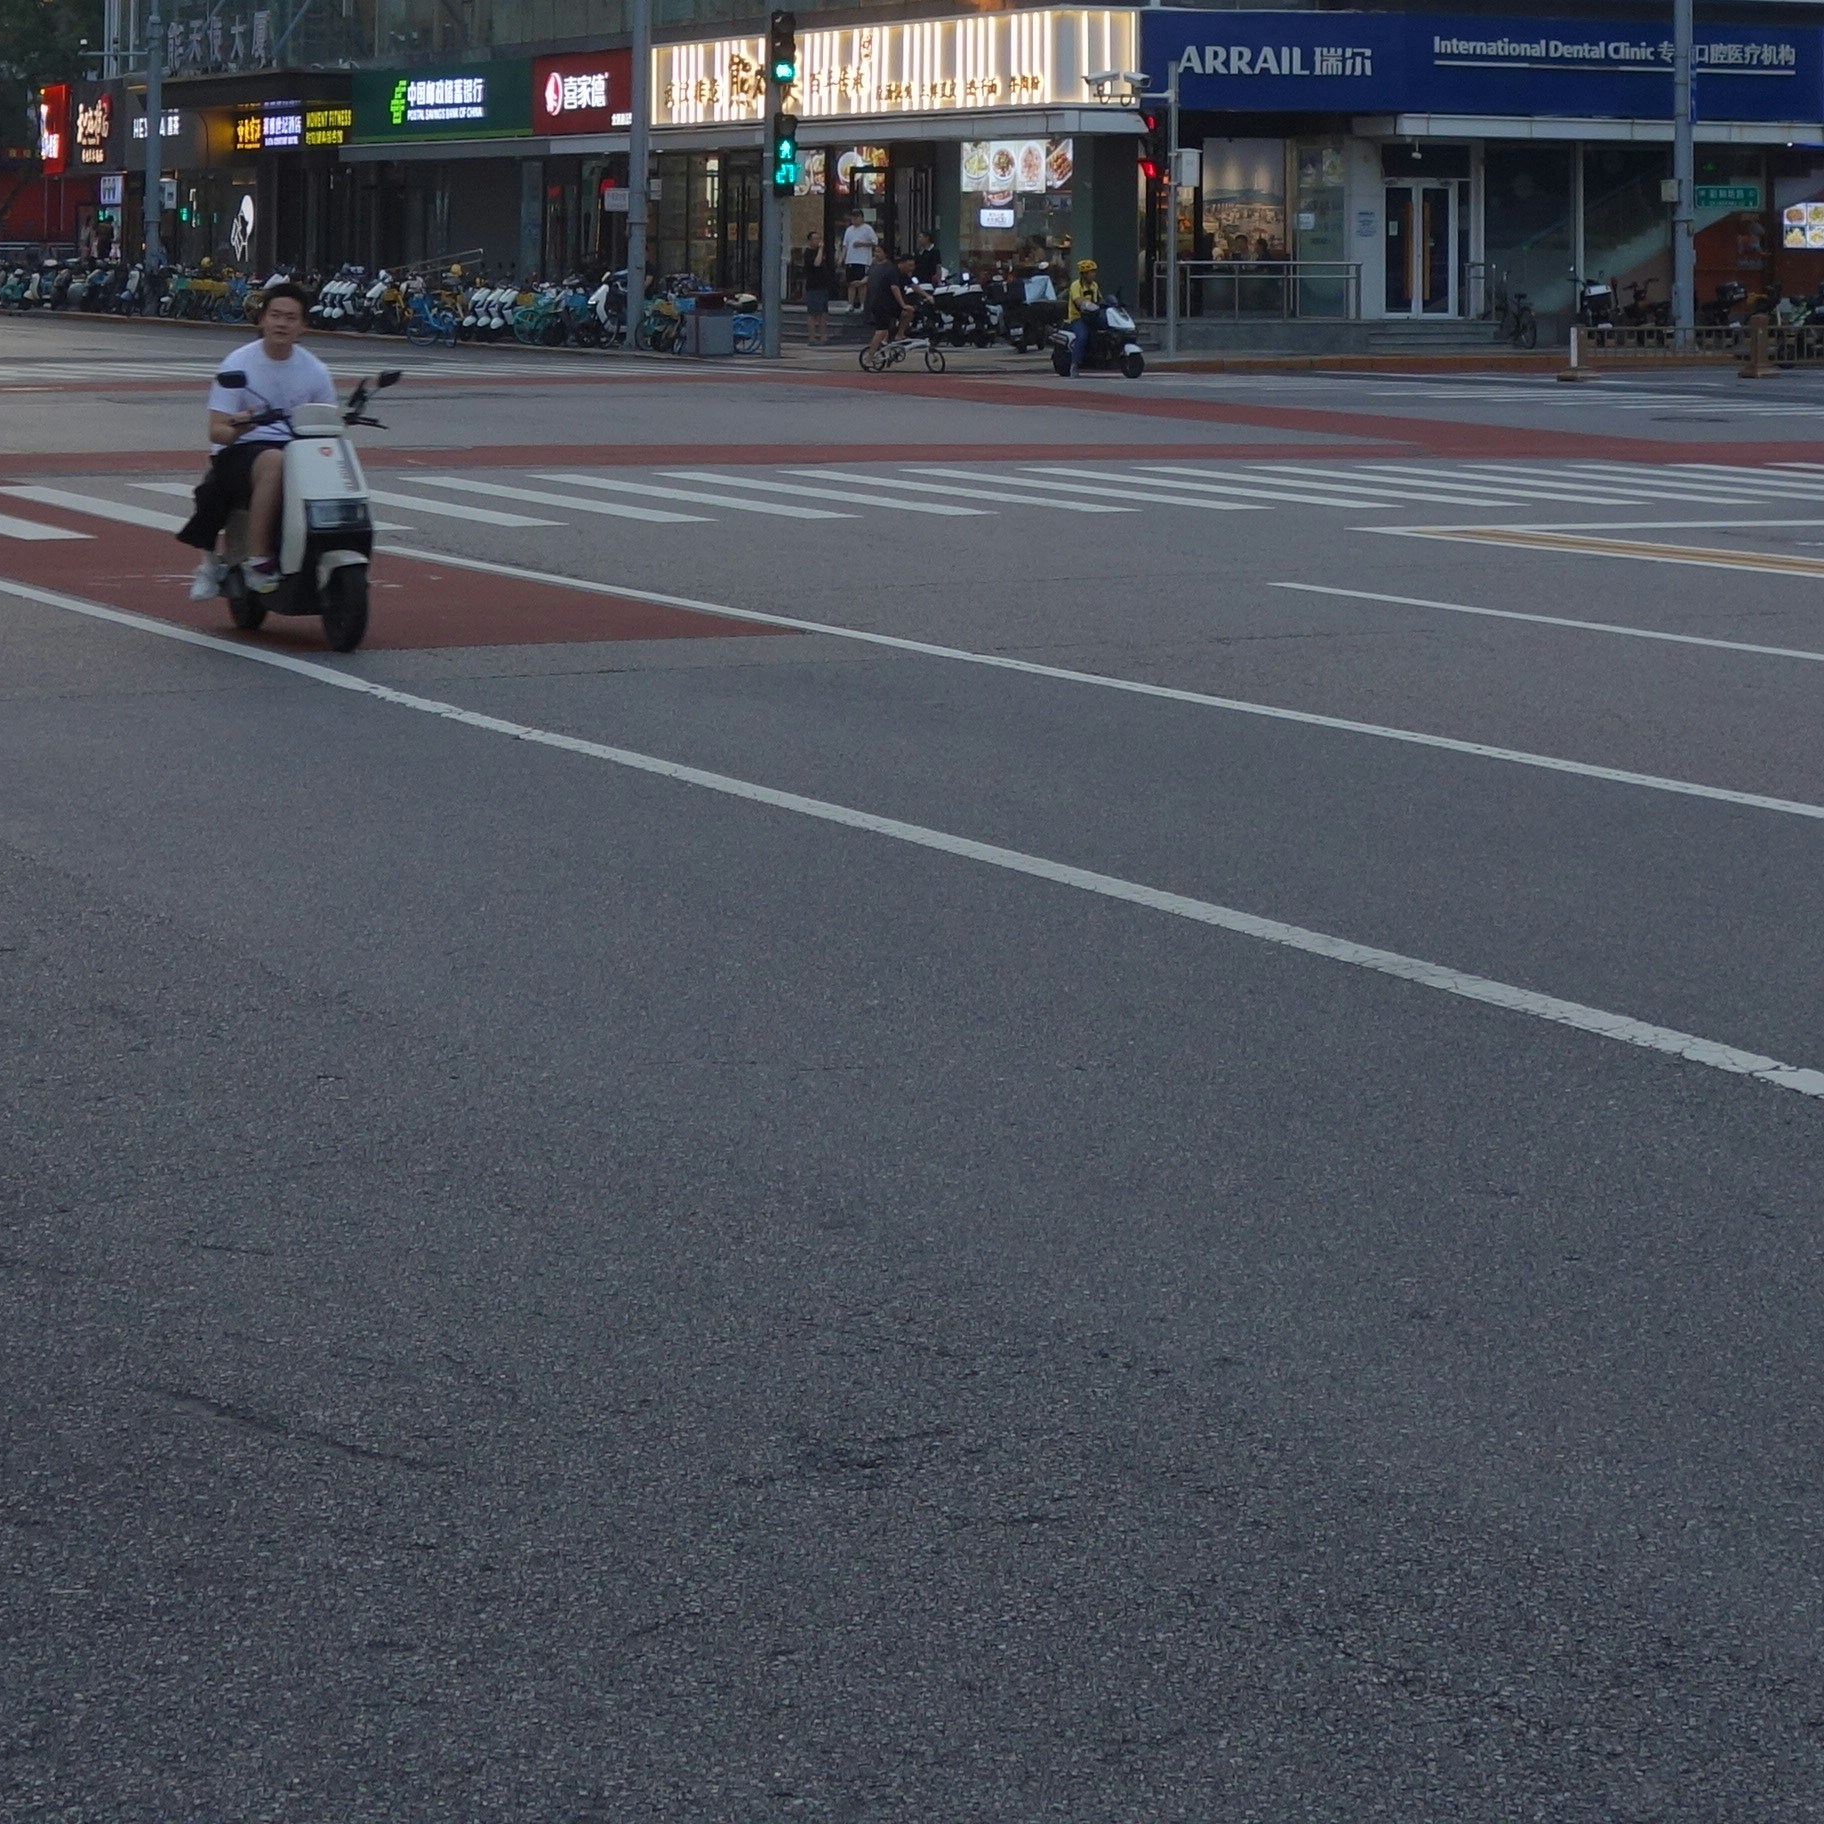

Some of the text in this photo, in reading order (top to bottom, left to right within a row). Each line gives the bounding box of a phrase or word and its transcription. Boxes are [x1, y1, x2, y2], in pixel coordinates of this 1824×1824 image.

[1178, 45, 1373, 76] ARRAIL 瑞尔
[1434, 35, 1796, 66] International Dental Clinic 专口腔医疗机构
[407, 78, 484, 106] 中国邮政储蓄银行
[563, 75, 607, 109] 喜家德
